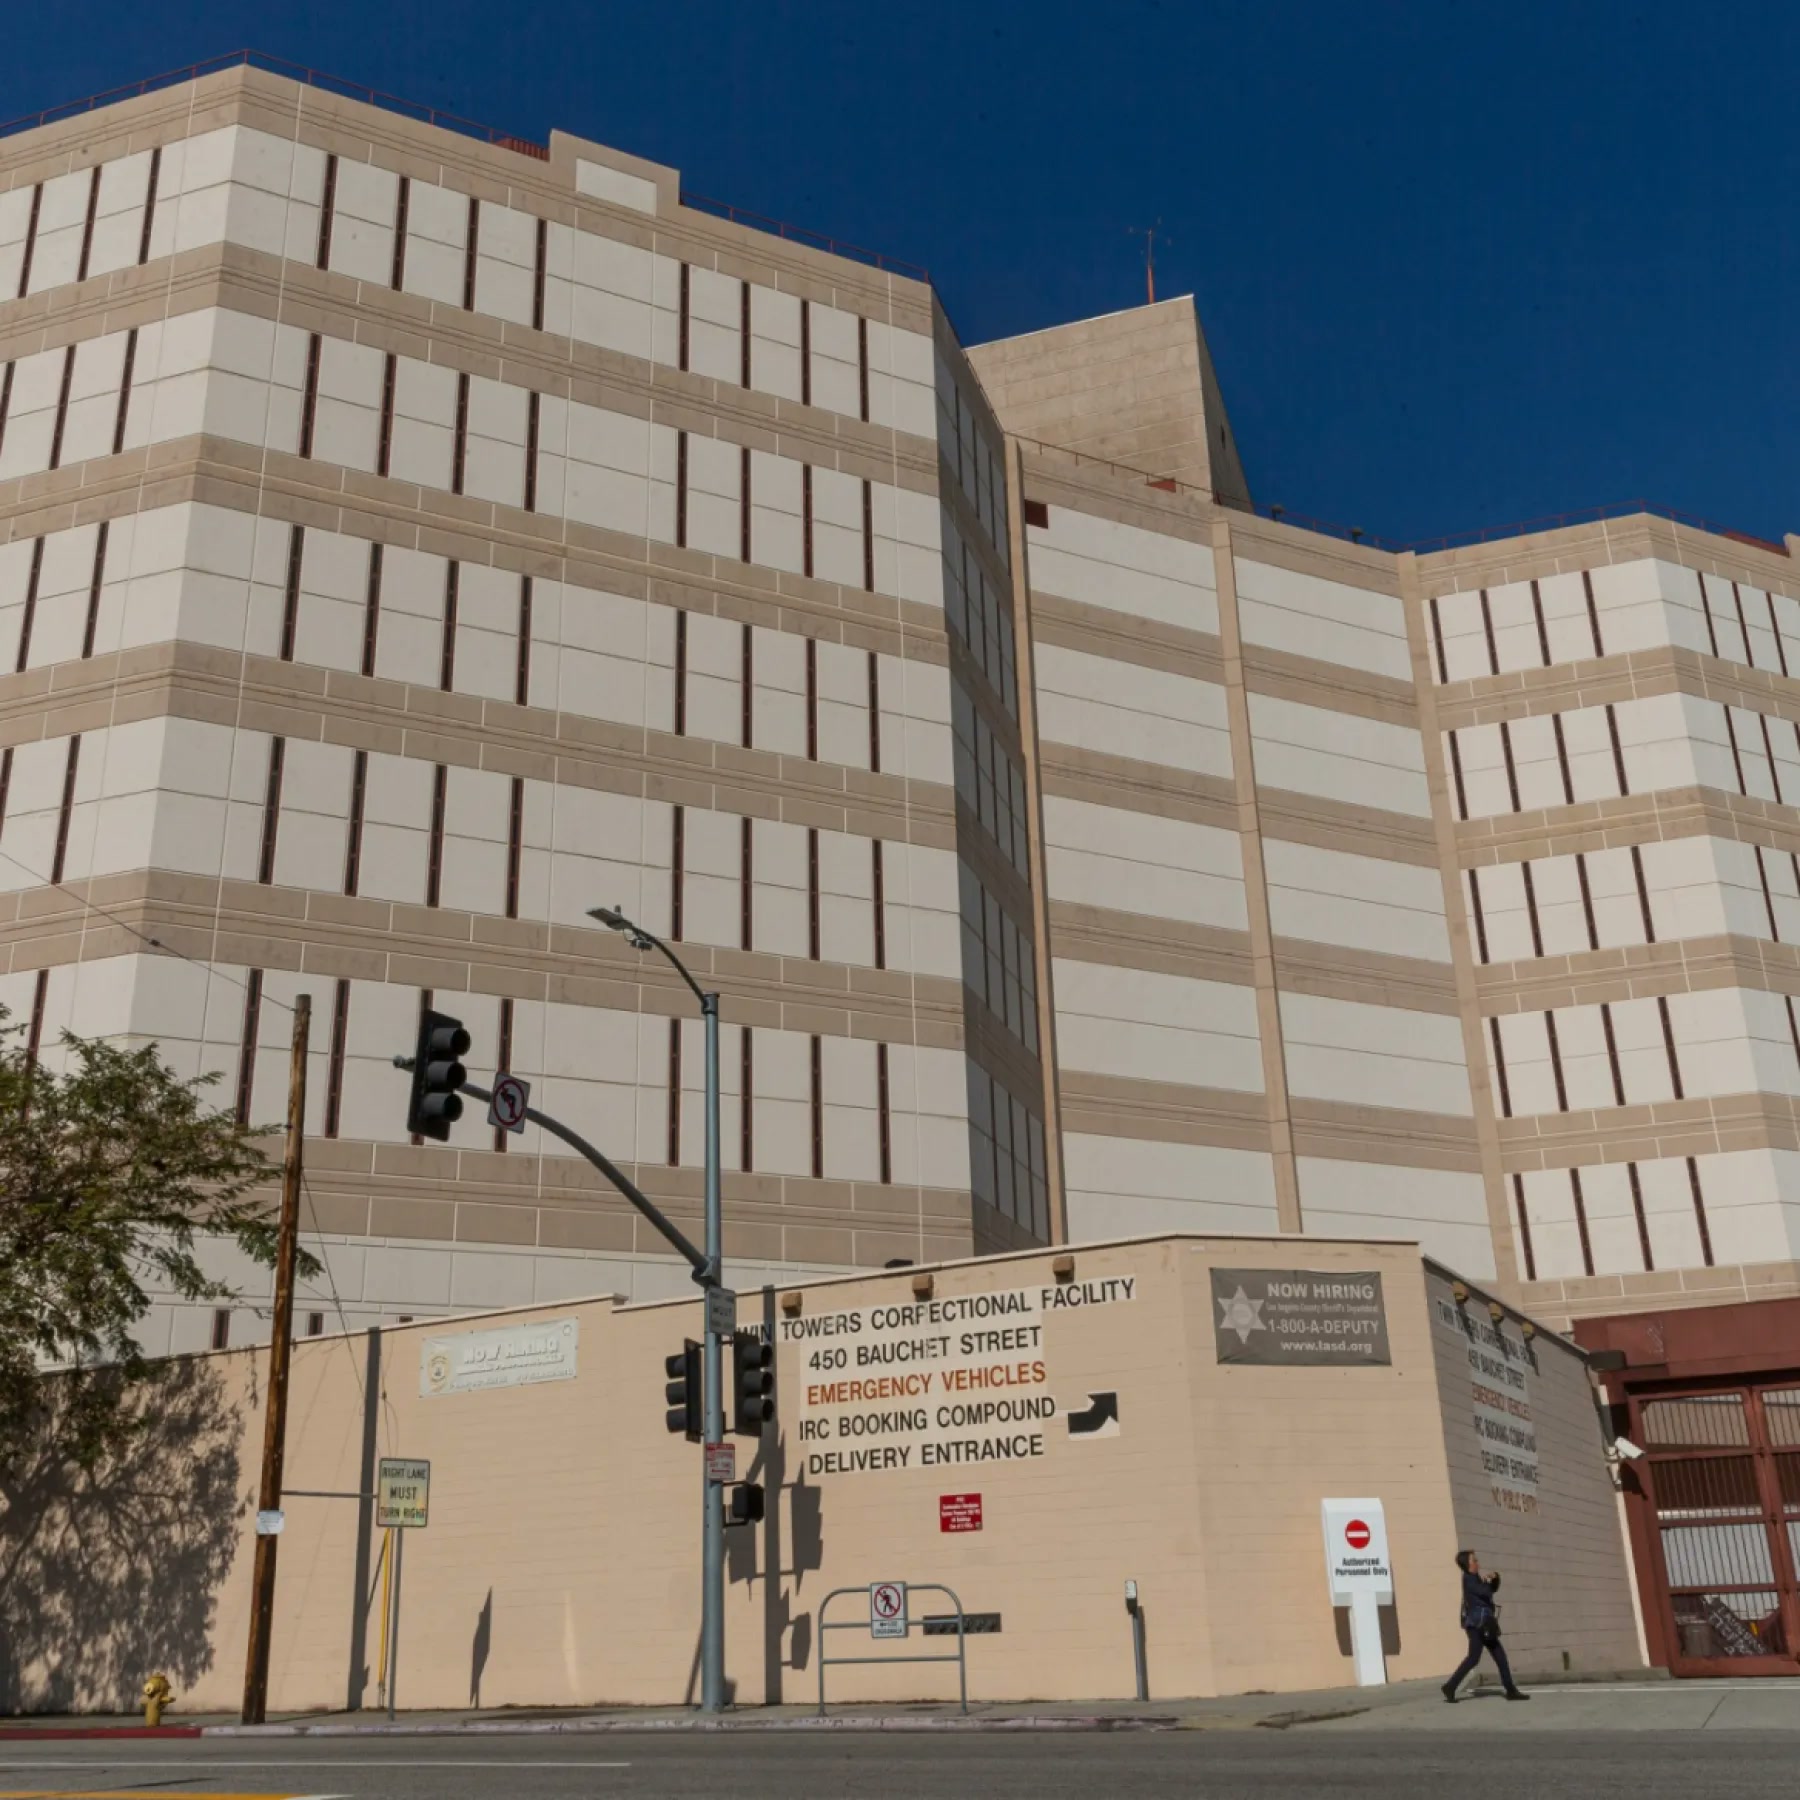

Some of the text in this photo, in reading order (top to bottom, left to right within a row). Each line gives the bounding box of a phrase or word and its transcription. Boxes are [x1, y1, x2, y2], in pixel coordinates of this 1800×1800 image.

[1267, 1283, 1374, 1299] NOW HIRING
[781, 1312, 861, 1340] TOWERS
[1042, 1278, 1134, 1310] FACILITY
[1268, 1319, 1378, 1334] 1-800-A-DEPUTY
[809, 1325, 1041, 1370] 450 BAUCHET STREET
[1280, 1340, 1372, 1354] www.lasd.org
[808, 1361, 1046, 1405] EMERGENCY VEHICLES
[800, 1396, 1055, 1441] IRC BOOKING COMPOUND
[809, 1434, 1043, 1474] DELIVERY ENTRANCE
[382, 1467, 426, 1479] RIGHT LANE
[390, 1486, 417, 1499] MUST
